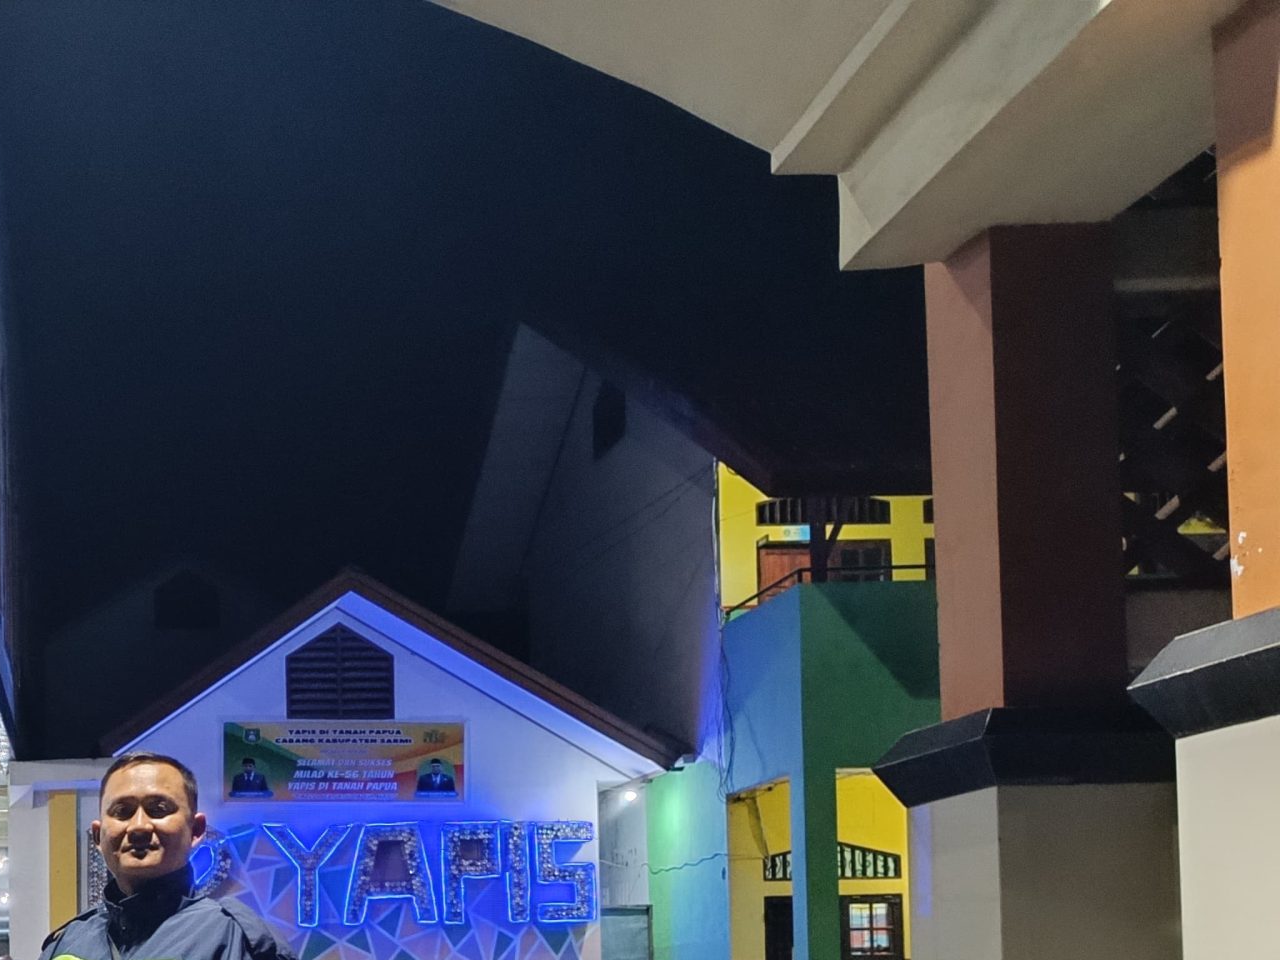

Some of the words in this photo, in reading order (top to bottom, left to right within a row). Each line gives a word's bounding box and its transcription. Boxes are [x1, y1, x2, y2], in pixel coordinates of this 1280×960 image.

[297, 759, 335, 767] SELAMAT
[359, 759, 393, 767] SUKSES
[293, 770, 325, 778] MILAD
[362, 770, 395, 778] TAHUN
[287, 782, 316, 791] YAPIS
[318, 782, 329, 791] DI
[332, 782, 365, 791] TANAH
[366, 782, 398, 791] PAPUA
[261, 818, 599, 926] YAPIS
